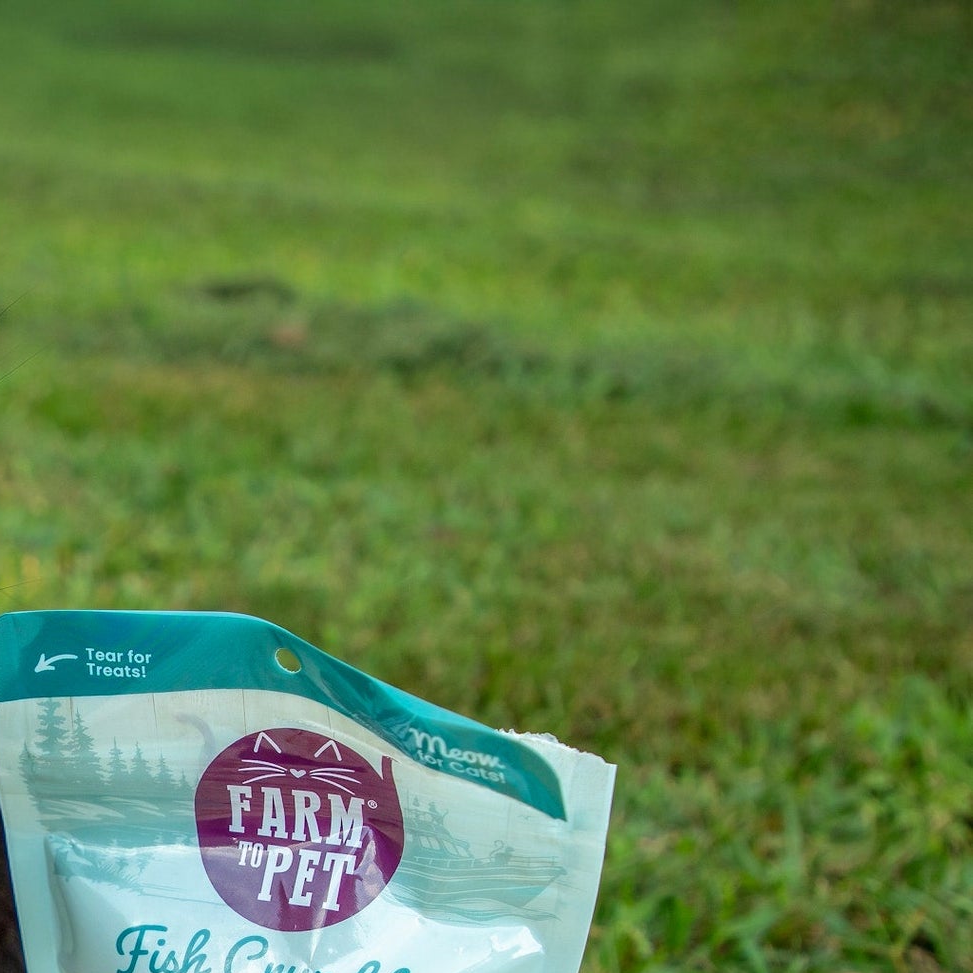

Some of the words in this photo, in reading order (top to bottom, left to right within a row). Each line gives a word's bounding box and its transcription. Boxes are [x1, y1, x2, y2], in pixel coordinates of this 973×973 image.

[85, 647, 123, 662] Tear
[127, 648, 152, 664] for
[86, 662, 147, 678] Treats!
[409, 727, 506, 769] Meow
[227, 784, 365, 848] FARM
[238, 840, 264, 868] TO
[257, 844, 357, 912] PET
